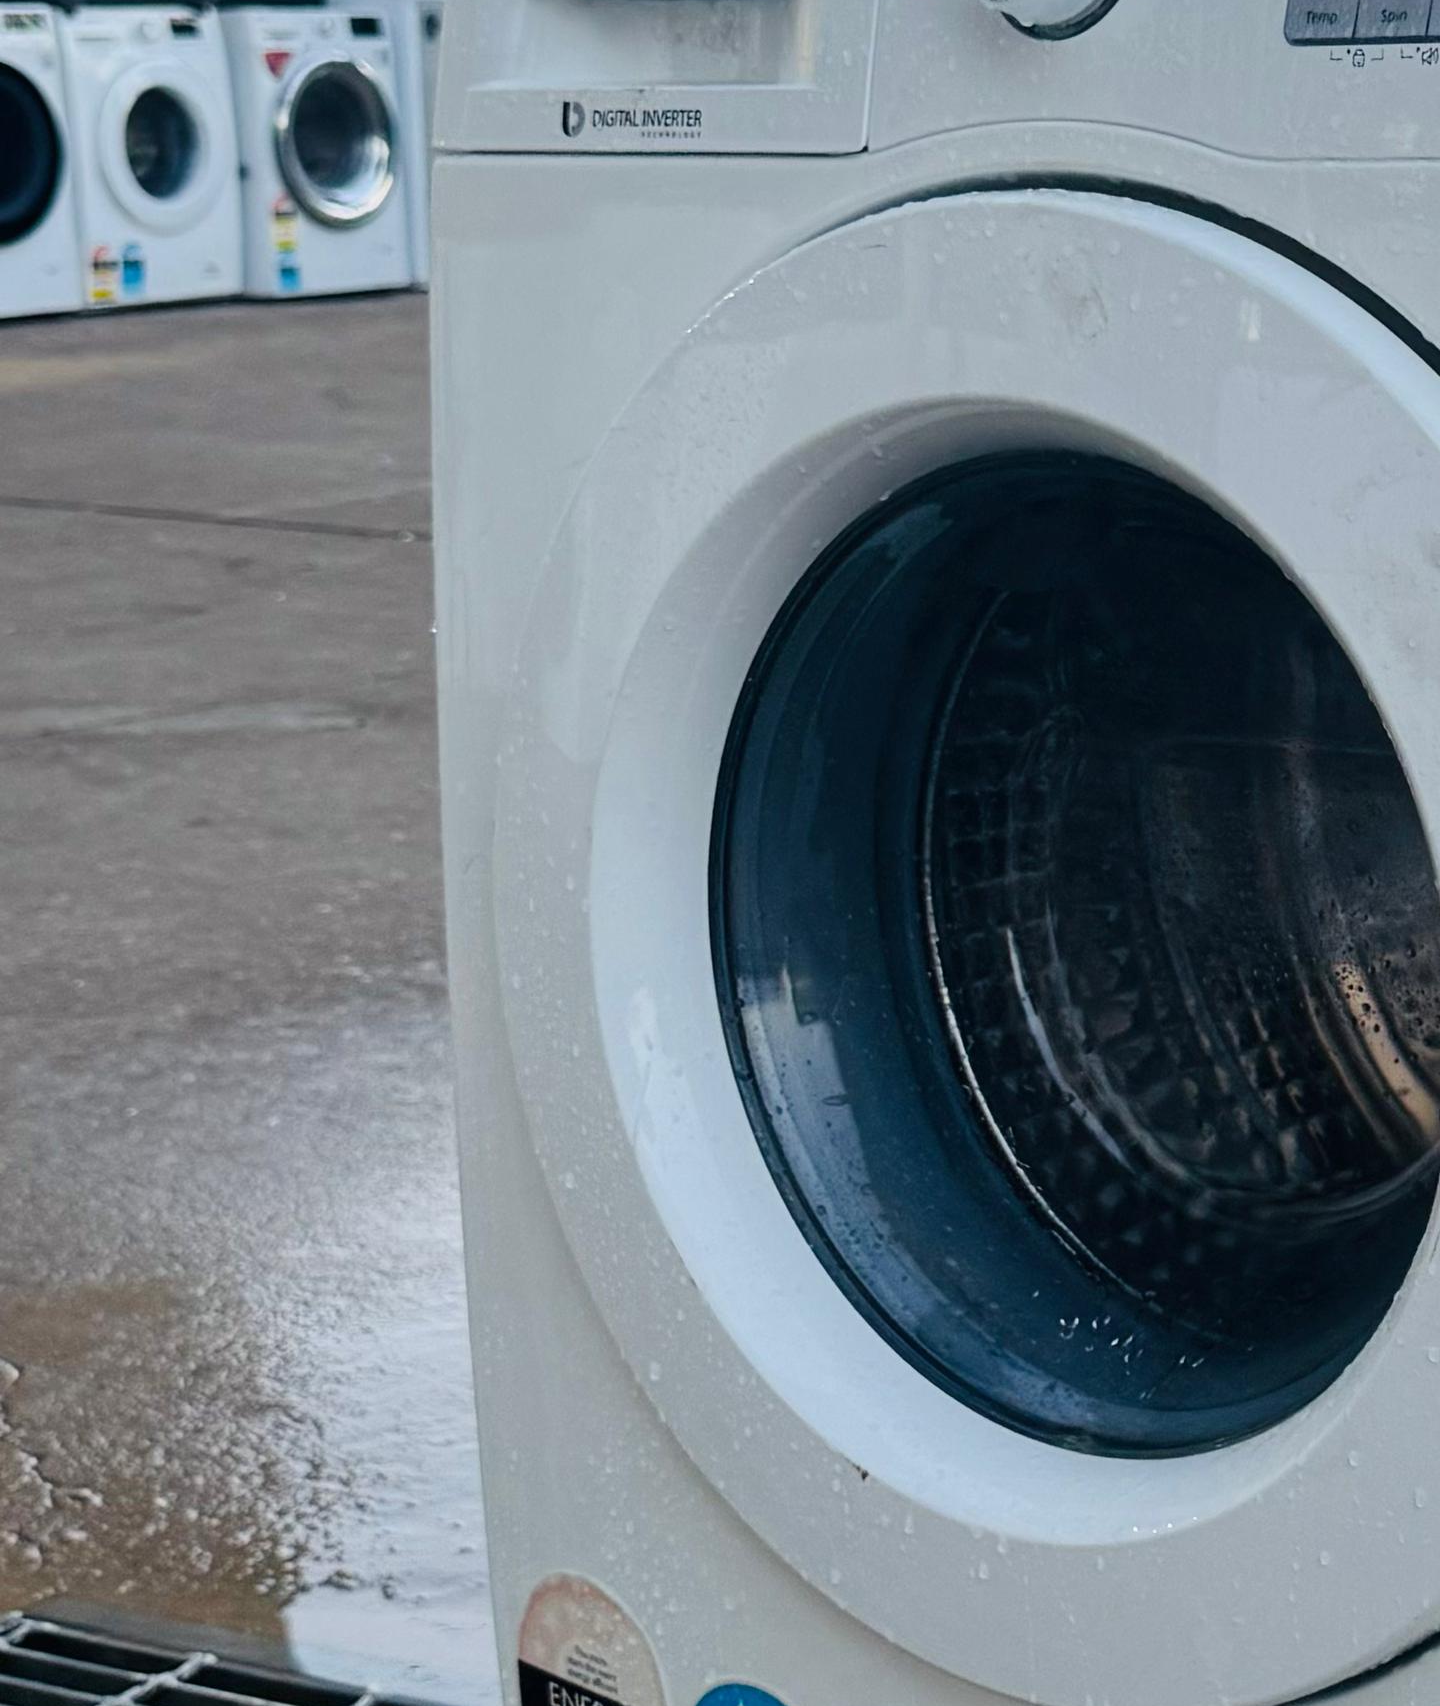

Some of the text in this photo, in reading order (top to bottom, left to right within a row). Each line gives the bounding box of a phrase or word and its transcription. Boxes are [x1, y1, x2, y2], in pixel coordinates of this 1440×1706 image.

[1306, 9, 1338, 25] Temp
[1380, 8, 1408, 24] Spin
[592, 108, 703, 128] DIGITAL INVERTER
